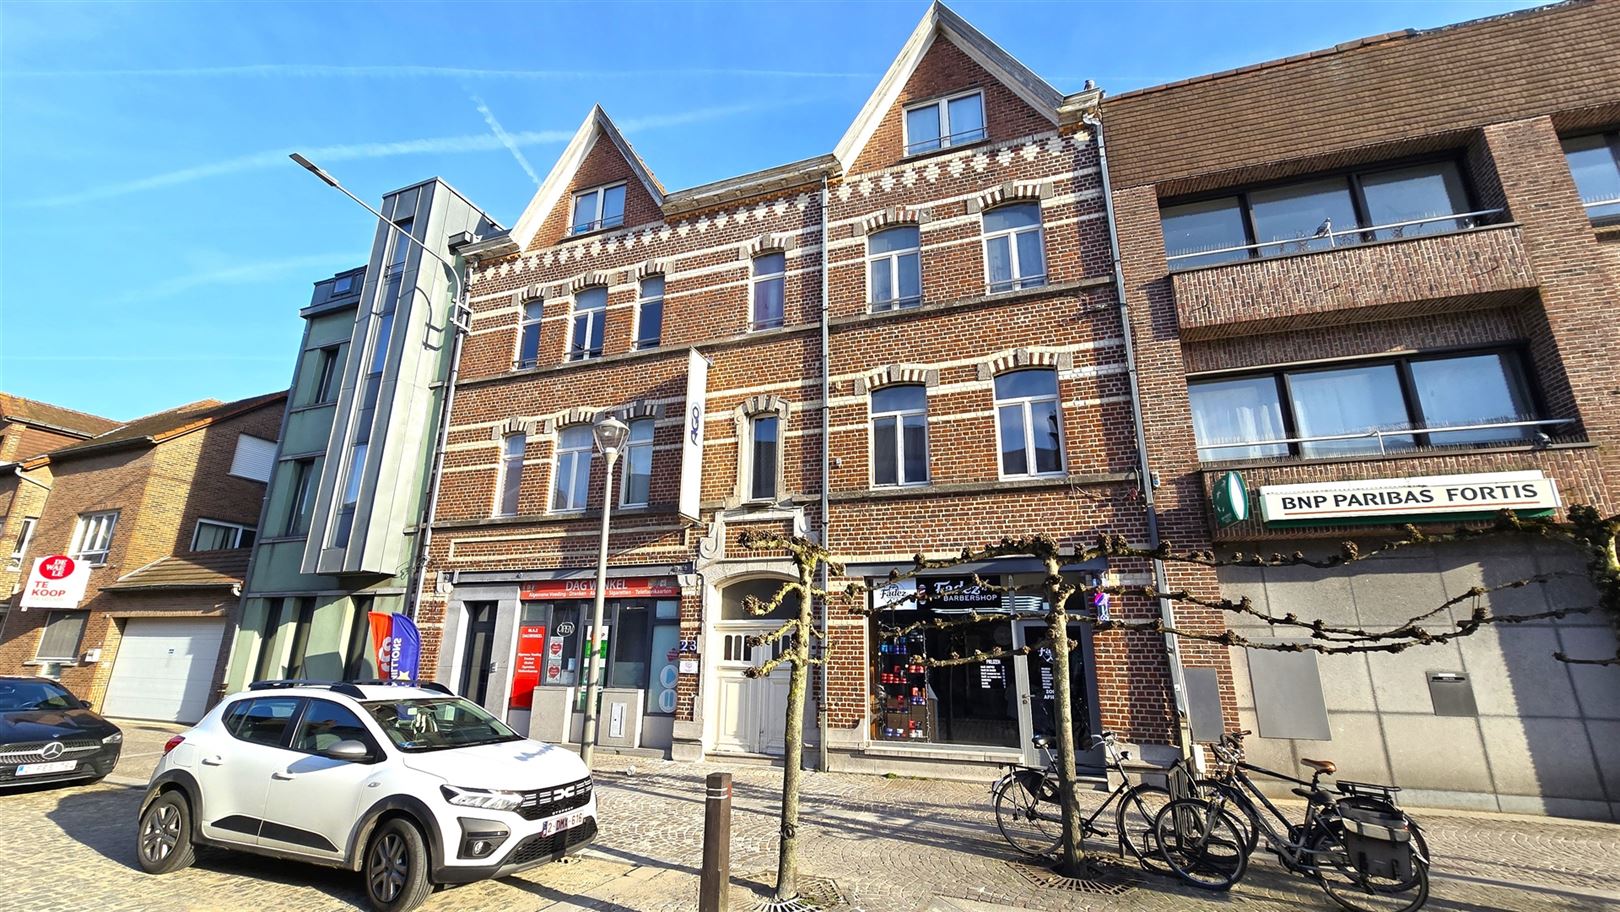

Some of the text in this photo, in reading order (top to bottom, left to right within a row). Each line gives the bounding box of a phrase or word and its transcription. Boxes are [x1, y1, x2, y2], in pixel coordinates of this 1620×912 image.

[1282, 483, 1539, 510] BNP PARIBAS FORTIS
[943, 594, 998, 602] BARBERSHOP
[679, 639, 697, 651] 23
